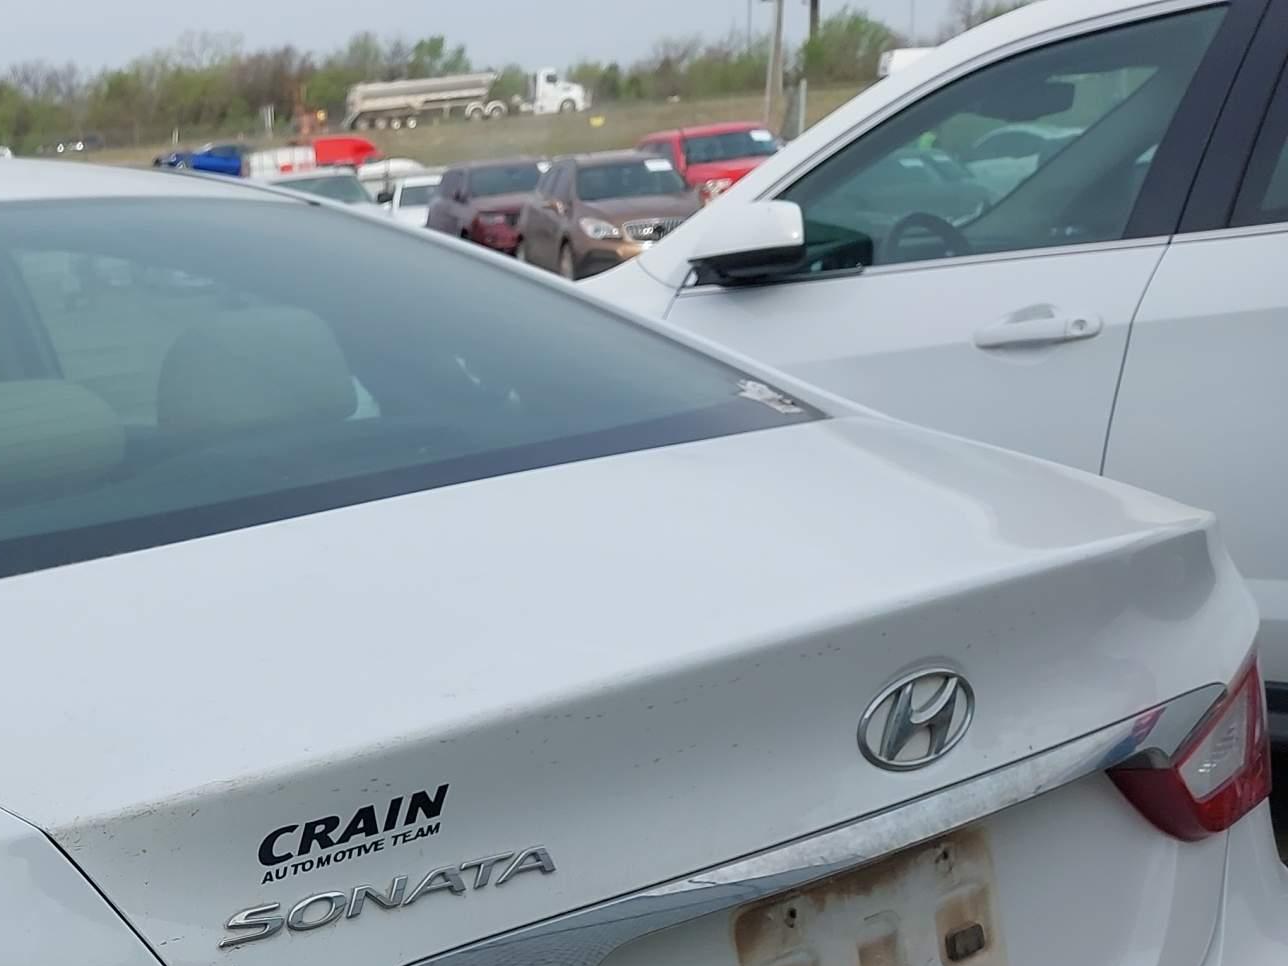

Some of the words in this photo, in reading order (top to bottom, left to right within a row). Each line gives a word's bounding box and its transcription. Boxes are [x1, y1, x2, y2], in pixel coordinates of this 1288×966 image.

[258, 783, 450, 867] CRAIN
[261, 838, 385, 885] AUTOMOTIVE
[392, 822, 441, 848] TEAM
[217, 844, 558, 950] SONATA
